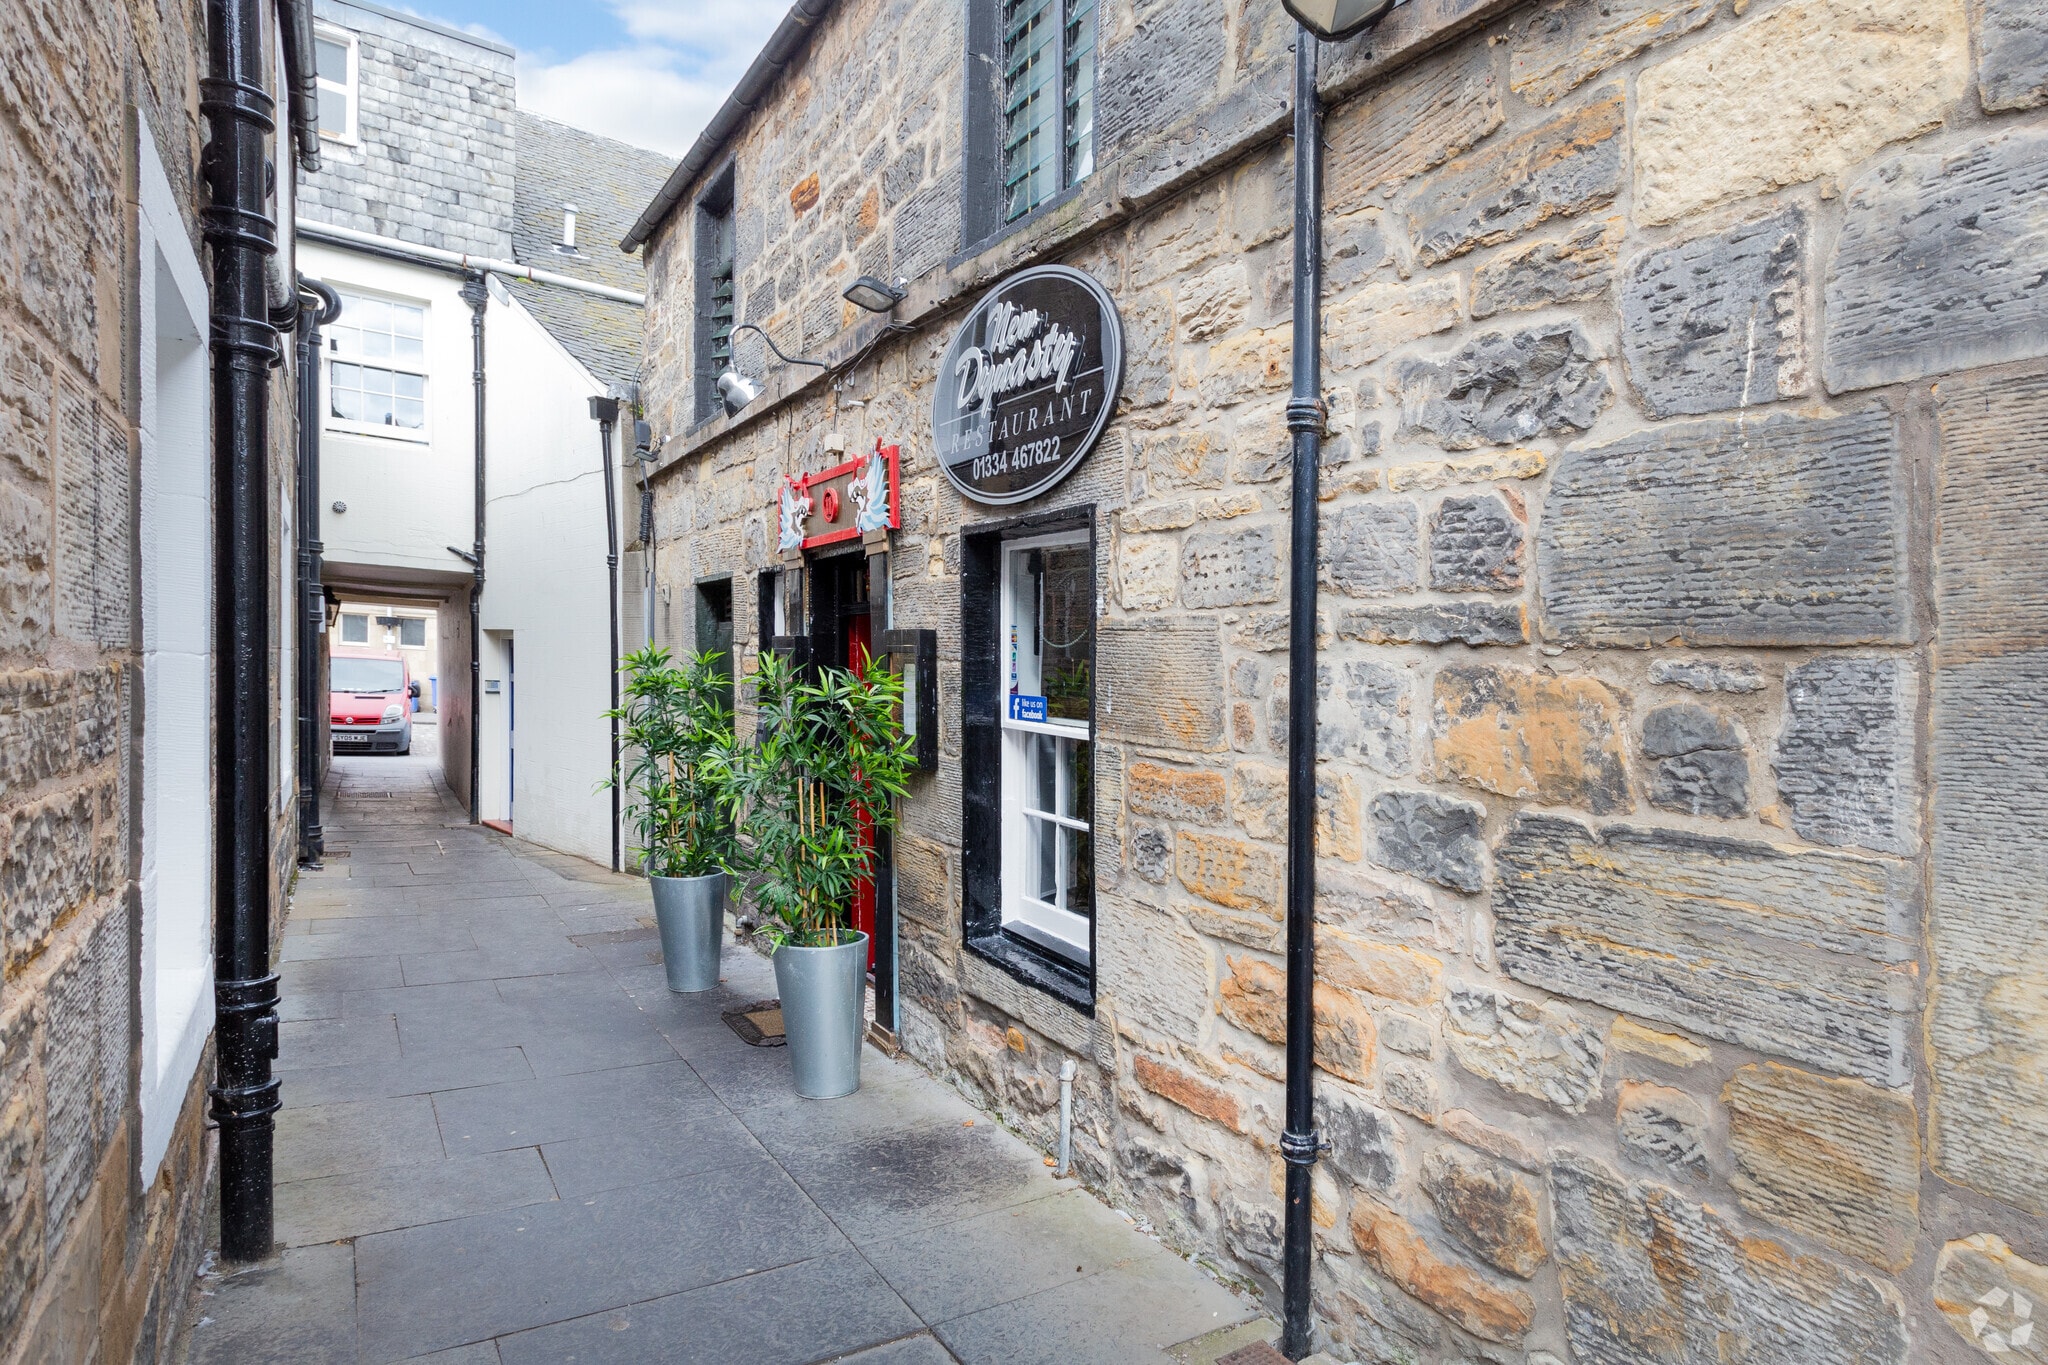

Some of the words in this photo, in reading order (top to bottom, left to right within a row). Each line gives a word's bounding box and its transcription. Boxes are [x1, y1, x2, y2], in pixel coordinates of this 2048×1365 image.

[987, 300, 1040, 354] New
[955, 323, 1075, 418] Dynasty
[950, 388, 1093, 455] RESTAURANT
[972, 449, 1008, 481] 01334
[1011, 435, 1061, 471] 467822
[1021, 698, 1030, 708] like
[1021, 708, 1043, 720] facebook
